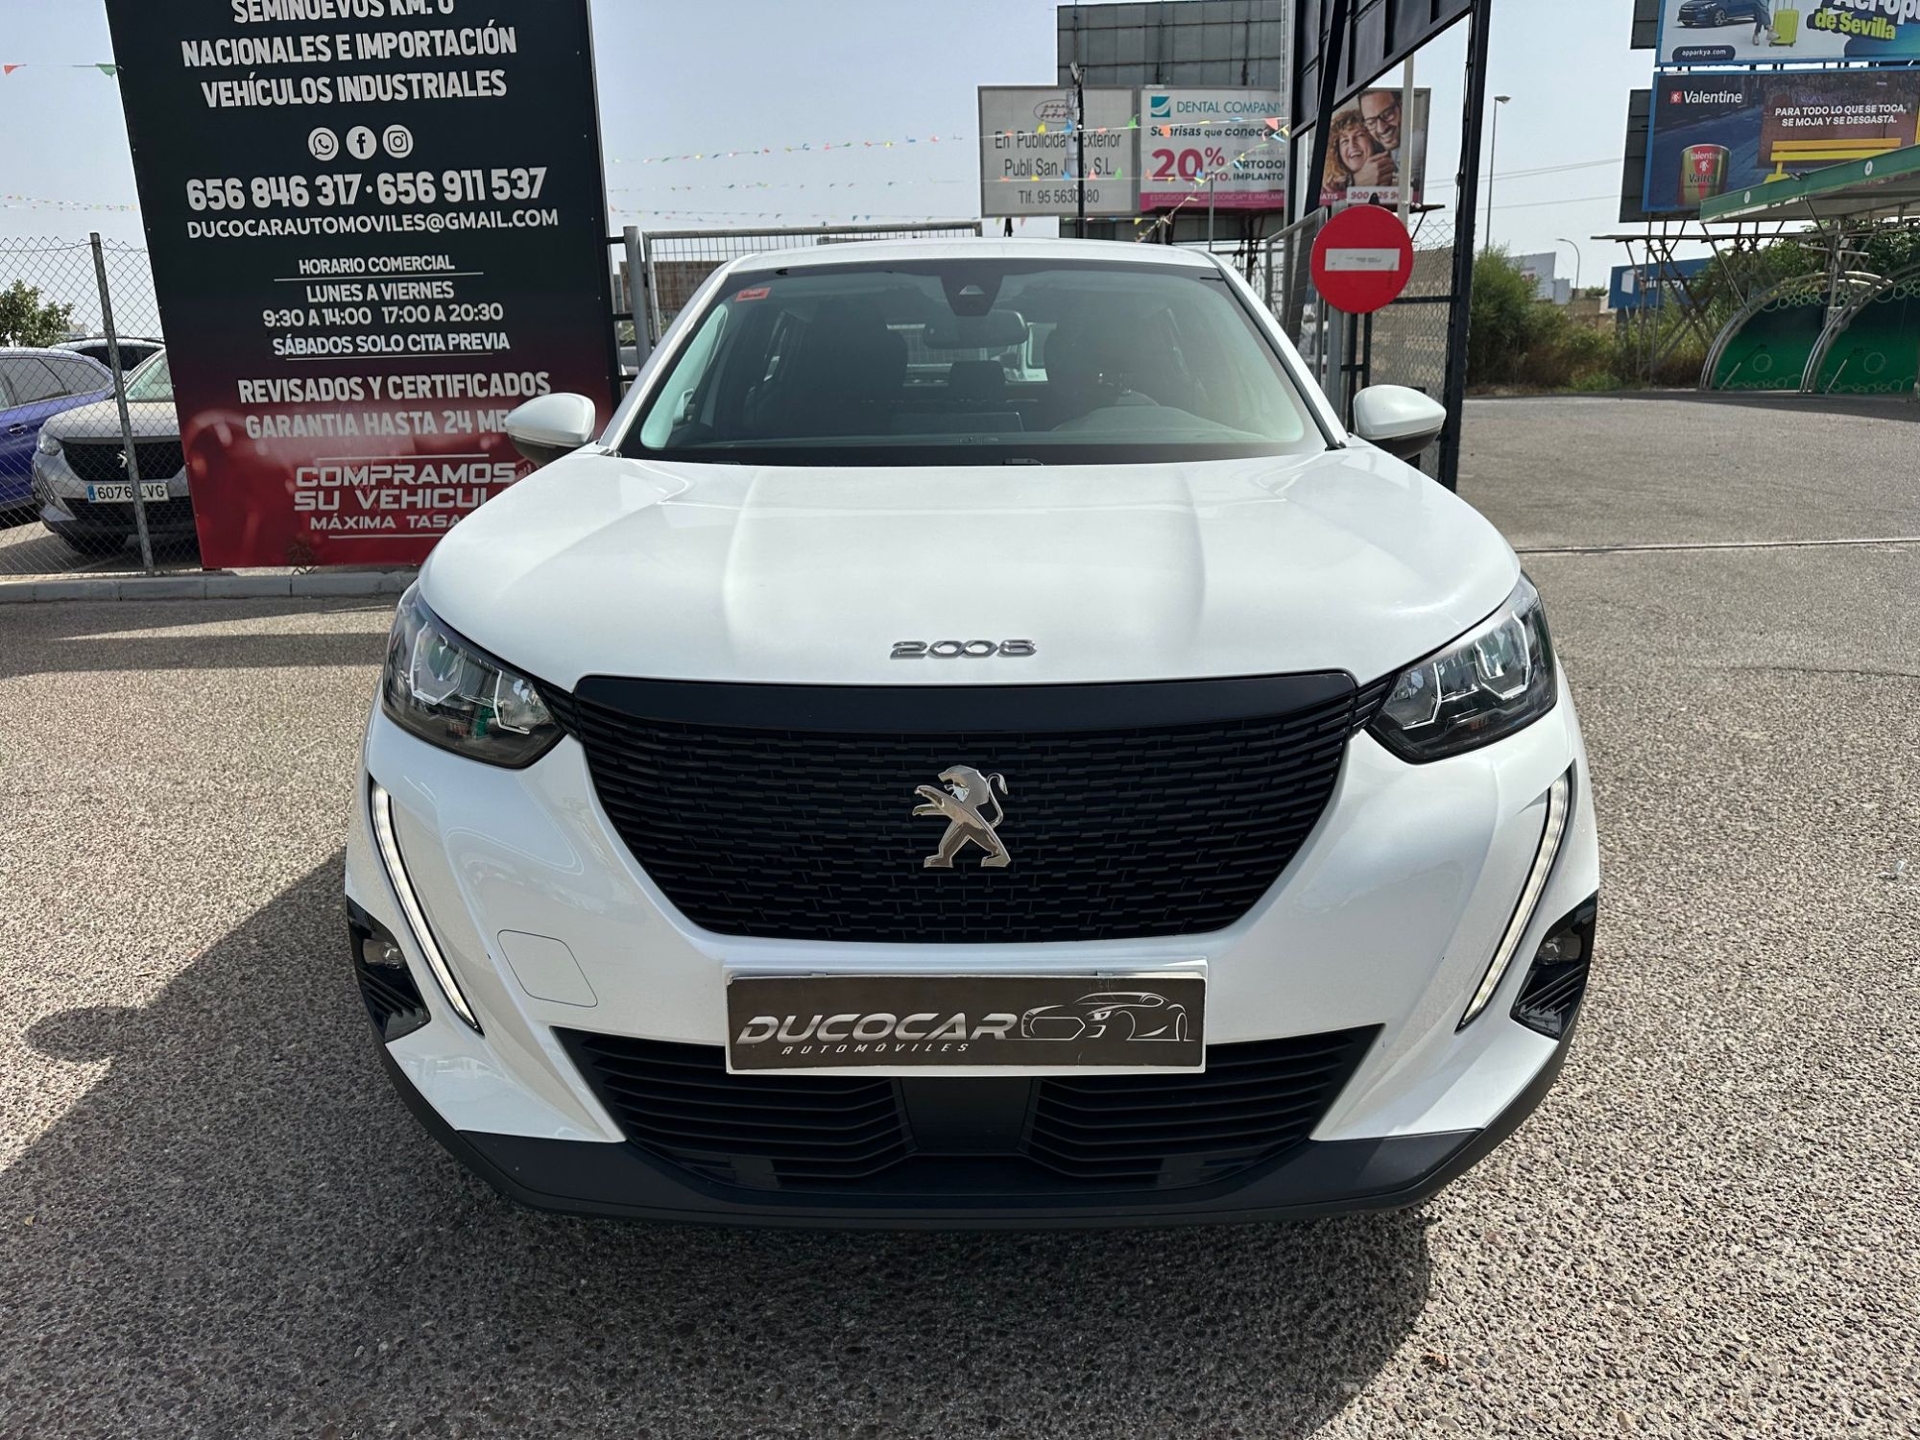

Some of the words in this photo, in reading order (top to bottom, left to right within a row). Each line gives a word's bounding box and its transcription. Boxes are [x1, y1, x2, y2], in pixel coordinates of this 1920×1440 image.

[234, 0, 385, 23] SEMINUEVOS
[1815, 8, 1837, 29] de
[1839, 12, 1896, 39] Sevilla
[181, 35, 331, 67] NACIONALES
[337, 35, 352, 60] E
[355, 20, 517, 59] IMPORTACIÓN
[201, 72, 333, 108] VEHÍCULOS
[337, 70, 507, 102] INDUSTRIALES
[1684, 90, 1742, 103] Valentine
[1177, 101, 1220, 113] DENTAL
[1775, 107, 1800, 116] PARA
[1802, 106, 1829, 115] TODO
[1831, 106, 1843, 114] LO
[1844, 105, 1863, 115] QUE
[1864, 105, 1876, 113] SE
[1878, 104, 1906, 114] TOCA,
[1782, 118, 1794, 126] SE
[1795, 117, 1823, 126] MOJA
[1826, 117, 1832, 125] Y
[1833, 117, 1846, 125] SE
[1847, 115, 1897, 125] DESGASTA.
[995, 131, 1010, 149] En
[1017, 131, 1067, 149] Publicida
[1204, 129, 1222, 138] que
[1005, 158, 1032, 176] Publi
[1036, 158, 1057, 176] San
[1094, 157, 1115, 175] S.L.
[186, 178, 245, 211] 656
[251, 175, 310, 208] 846
[442, 169, 484, 202] 911
[491, 167, 547, 200] 537
[1018, 191, 1035, 204] Tlf.
[1038, 190, 1051, 203] 95
[187, 209, 558, 239] DUCOCARAUTOMOVILES@GMAIL.COM
[298, 256, 366, 275] HORARIO
[368, 255, 455, 272] COMERCIAL
[306, 284, 362, 303] LUNES
[366, 284, 377, 300] A
[380, 281, 454, 299] VIERNES
[262, 308, 304, 327] 9:30
[308, 308, 320, 325] A
[322, 306, 372, 325] 14:00
[381, 305, 431, 324] 17:00
[434, 305, 447, 322] A
[448, 302, 503, 321] 20:30
[272, 332, 353, 356] SÁBADOS
[356, 335, 404, 354] SOLO
[407, 334, 444, 352] CITA
[447, 332, 510, 352] PREVIA
[238, 377, 365, 404] REVISADOS
[367, 376, 383, 399] Y
[387, 371, 551, 399] CERTIFICADOS
[246, 411, 356, 439] GARANTIA
[363, 410, 437, 436] HASTA
[442, 410, 472, 434] 24
[477, 409, 508, 433] ME
[296, 463, 516, 487] COMPRAMOS
[97, 486, 133, 499] 6076
[294, 491, 340, 511] SU
[310, 513, 396, 530] MÁXIMA
[890, 639, 1037, 660] 2008
[735, 1013, 1018, 1045] DUCOCAR
[782, 1043, 969, 1055] AUTOMÓVILES
